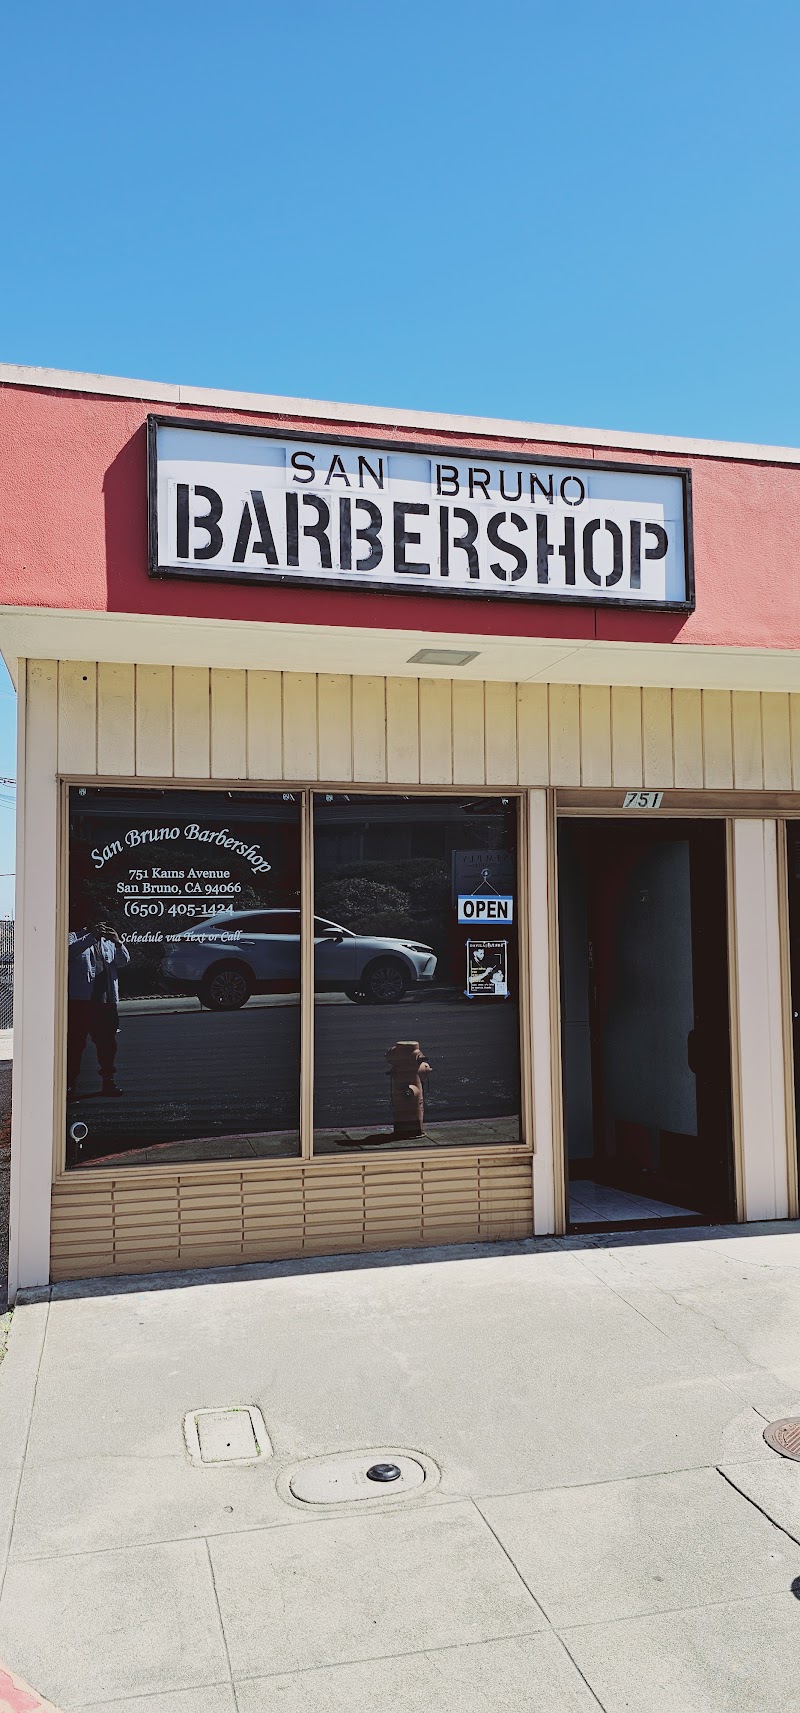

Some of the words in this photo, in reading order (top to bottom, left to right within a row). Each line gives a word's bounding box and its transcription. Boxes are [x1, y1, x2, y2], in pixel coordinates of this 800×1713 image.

[291, 450, 385, 490] SAN
[435, 463, 586, 507] BRUNO
[176, 482, 669, 590] BARBERSHOP
[624, 792, 659, 808] 751
[91, 840, 124, 869] San
[124, 827, 180, 848] Bruno
[183, 823, 272, 875] Barbershop
[128, 869, 149, 881] 751
[151, 867, 185, 879] Kains
[187, 867, 231, 879] Avenue
[116, 881, 140, 893] San
[142, 882, 182, 895] Bruno,
[184, 882, 203, 893] CA
[204, 882, 242, 895] 94066
[124, 901, 164, 918] (650)
[167, 903, 235, 917] 405-1424
[463, 900, 508, 919] OPEN
[119, 931, 163, 944] Schedule
[165, 934, 182, 943] via
[183, 931, 207, 944] Text
[208, 934, 218, 942] or
[220, 930, 243, 942] Call
